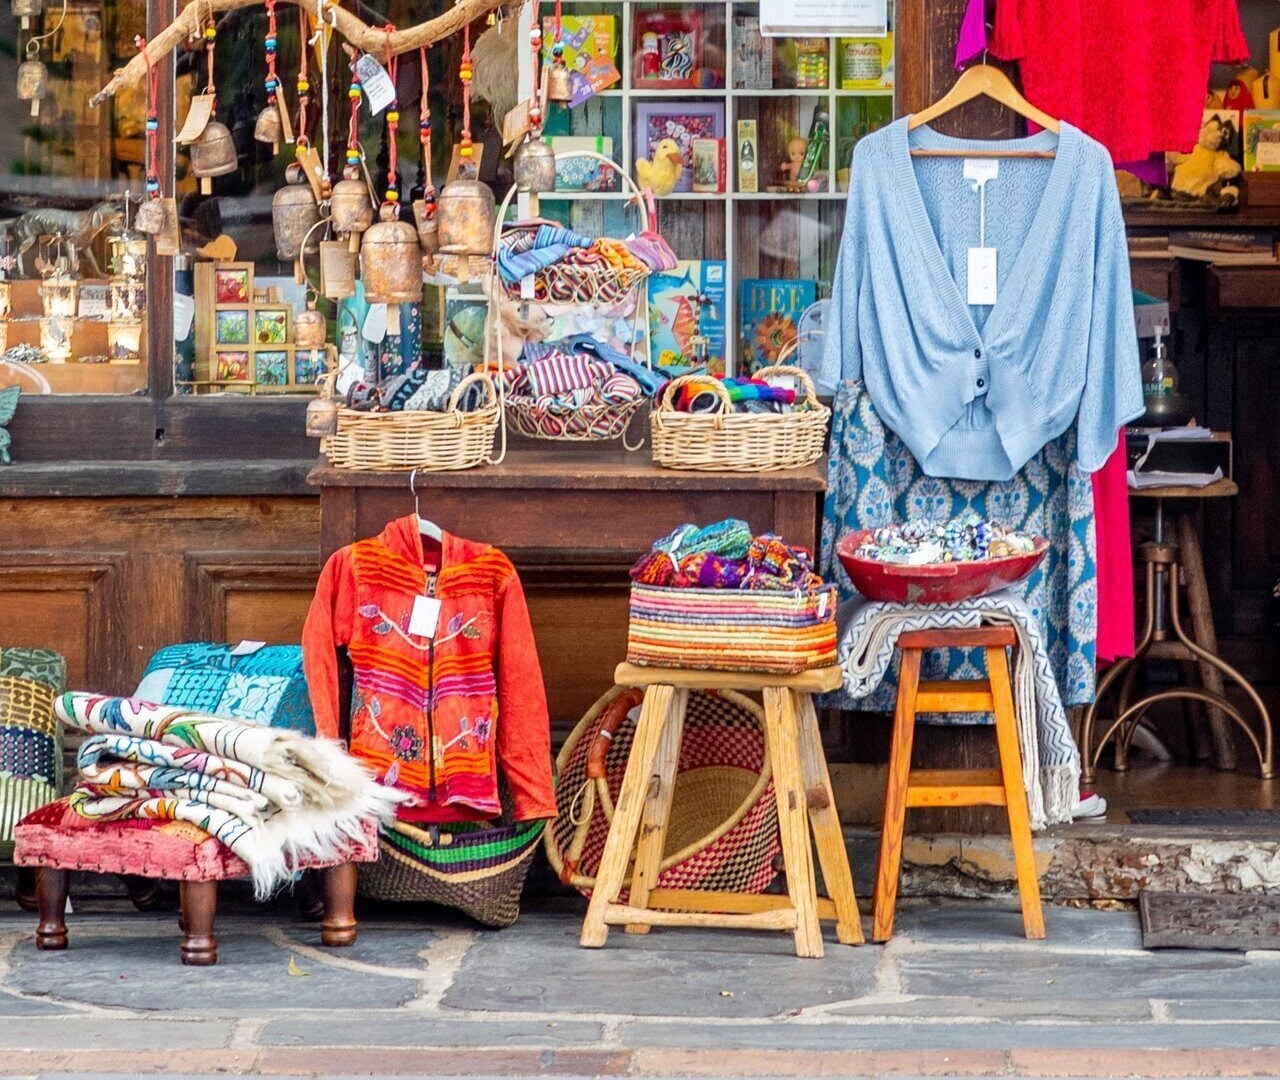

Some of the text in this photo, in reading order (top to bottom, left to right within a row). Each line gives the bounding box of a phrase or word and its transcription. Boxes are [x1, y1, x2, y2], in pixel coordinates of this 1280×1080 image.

[580, 85, 591, 95] 28
[751, 288, 805, 312] BEE
[1143, 383, 1165, 392] AND
